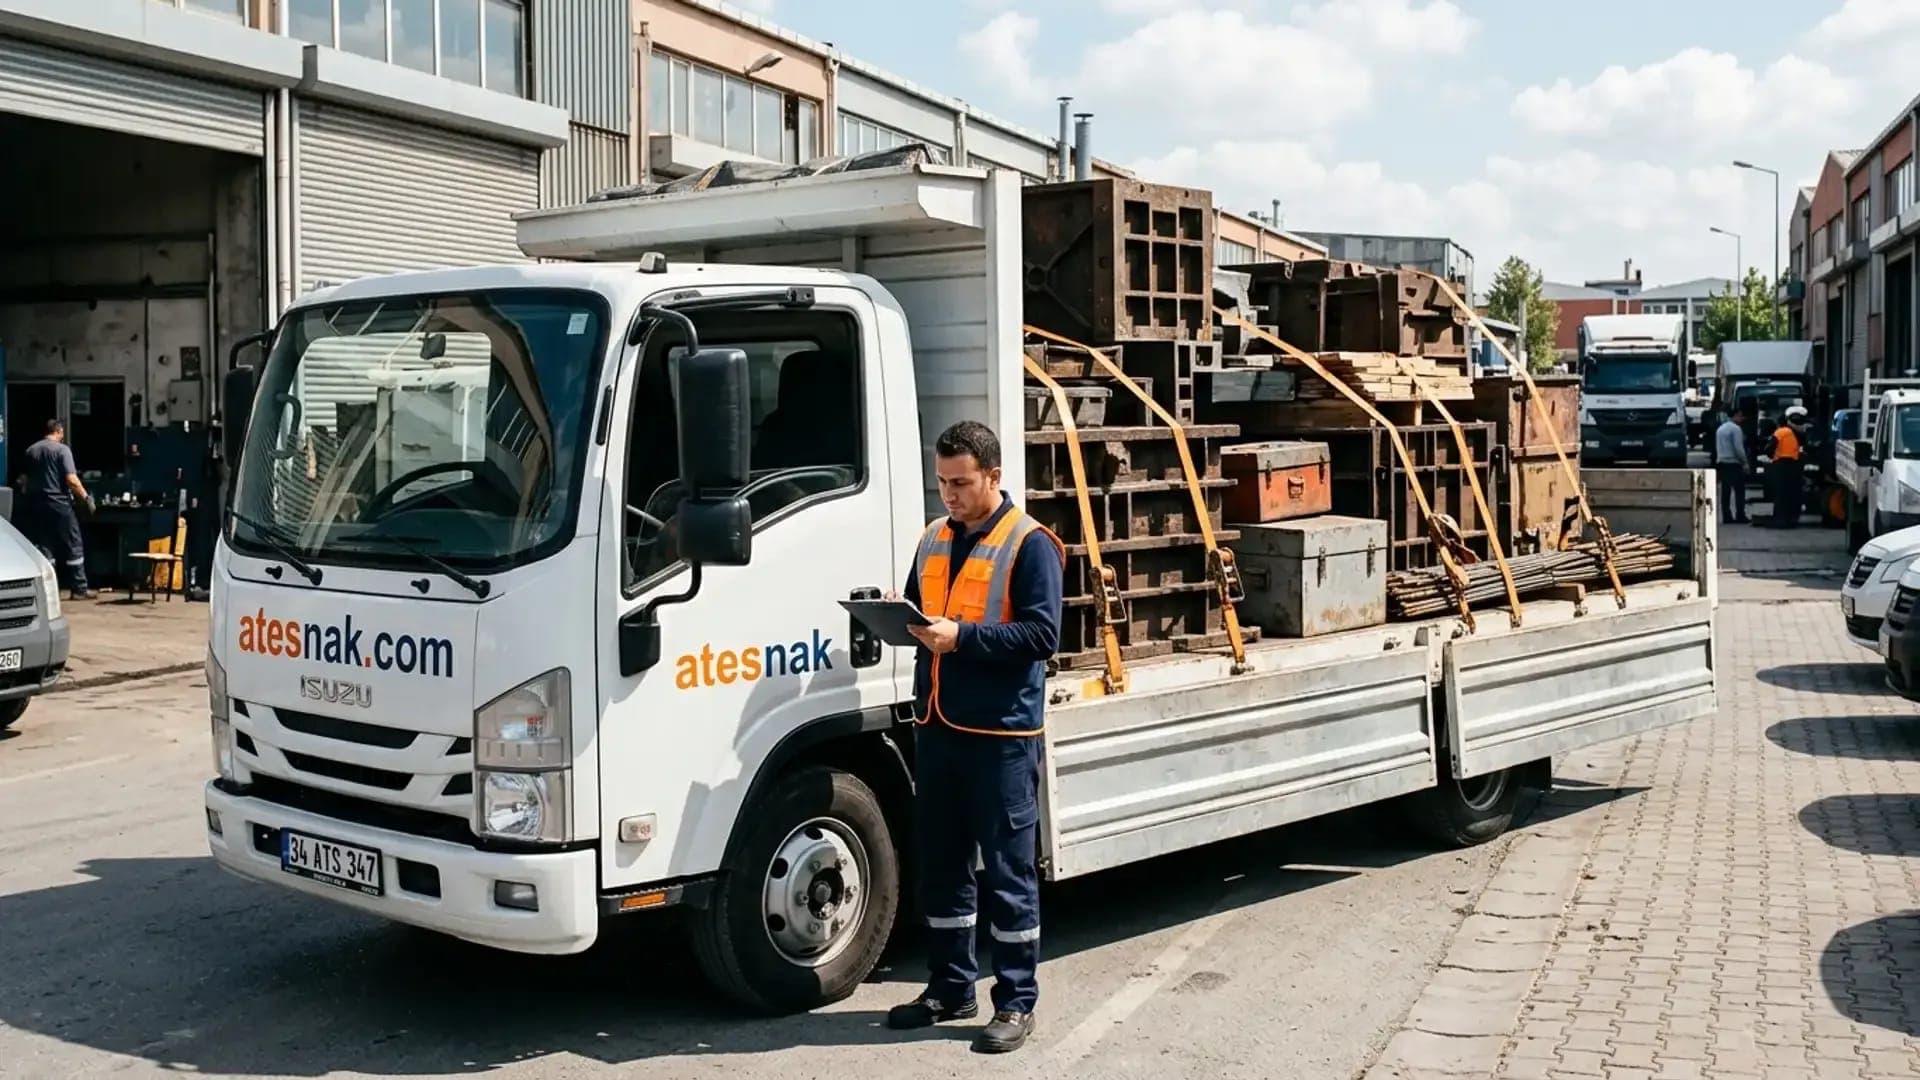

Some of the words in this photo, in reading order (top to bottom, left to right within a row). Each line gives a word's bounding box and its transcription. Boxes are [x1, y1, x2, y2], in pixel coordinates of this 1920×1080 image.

[239, 607, 454, 678] atesnak.com
[675, 628, 833, 690] atesnak
[301, 674, 372, 708] ISUZU
[290, 836, 308, 866] 34
[314, 842, 341, 874] ATS
[347, 850, 376, 883] 347
